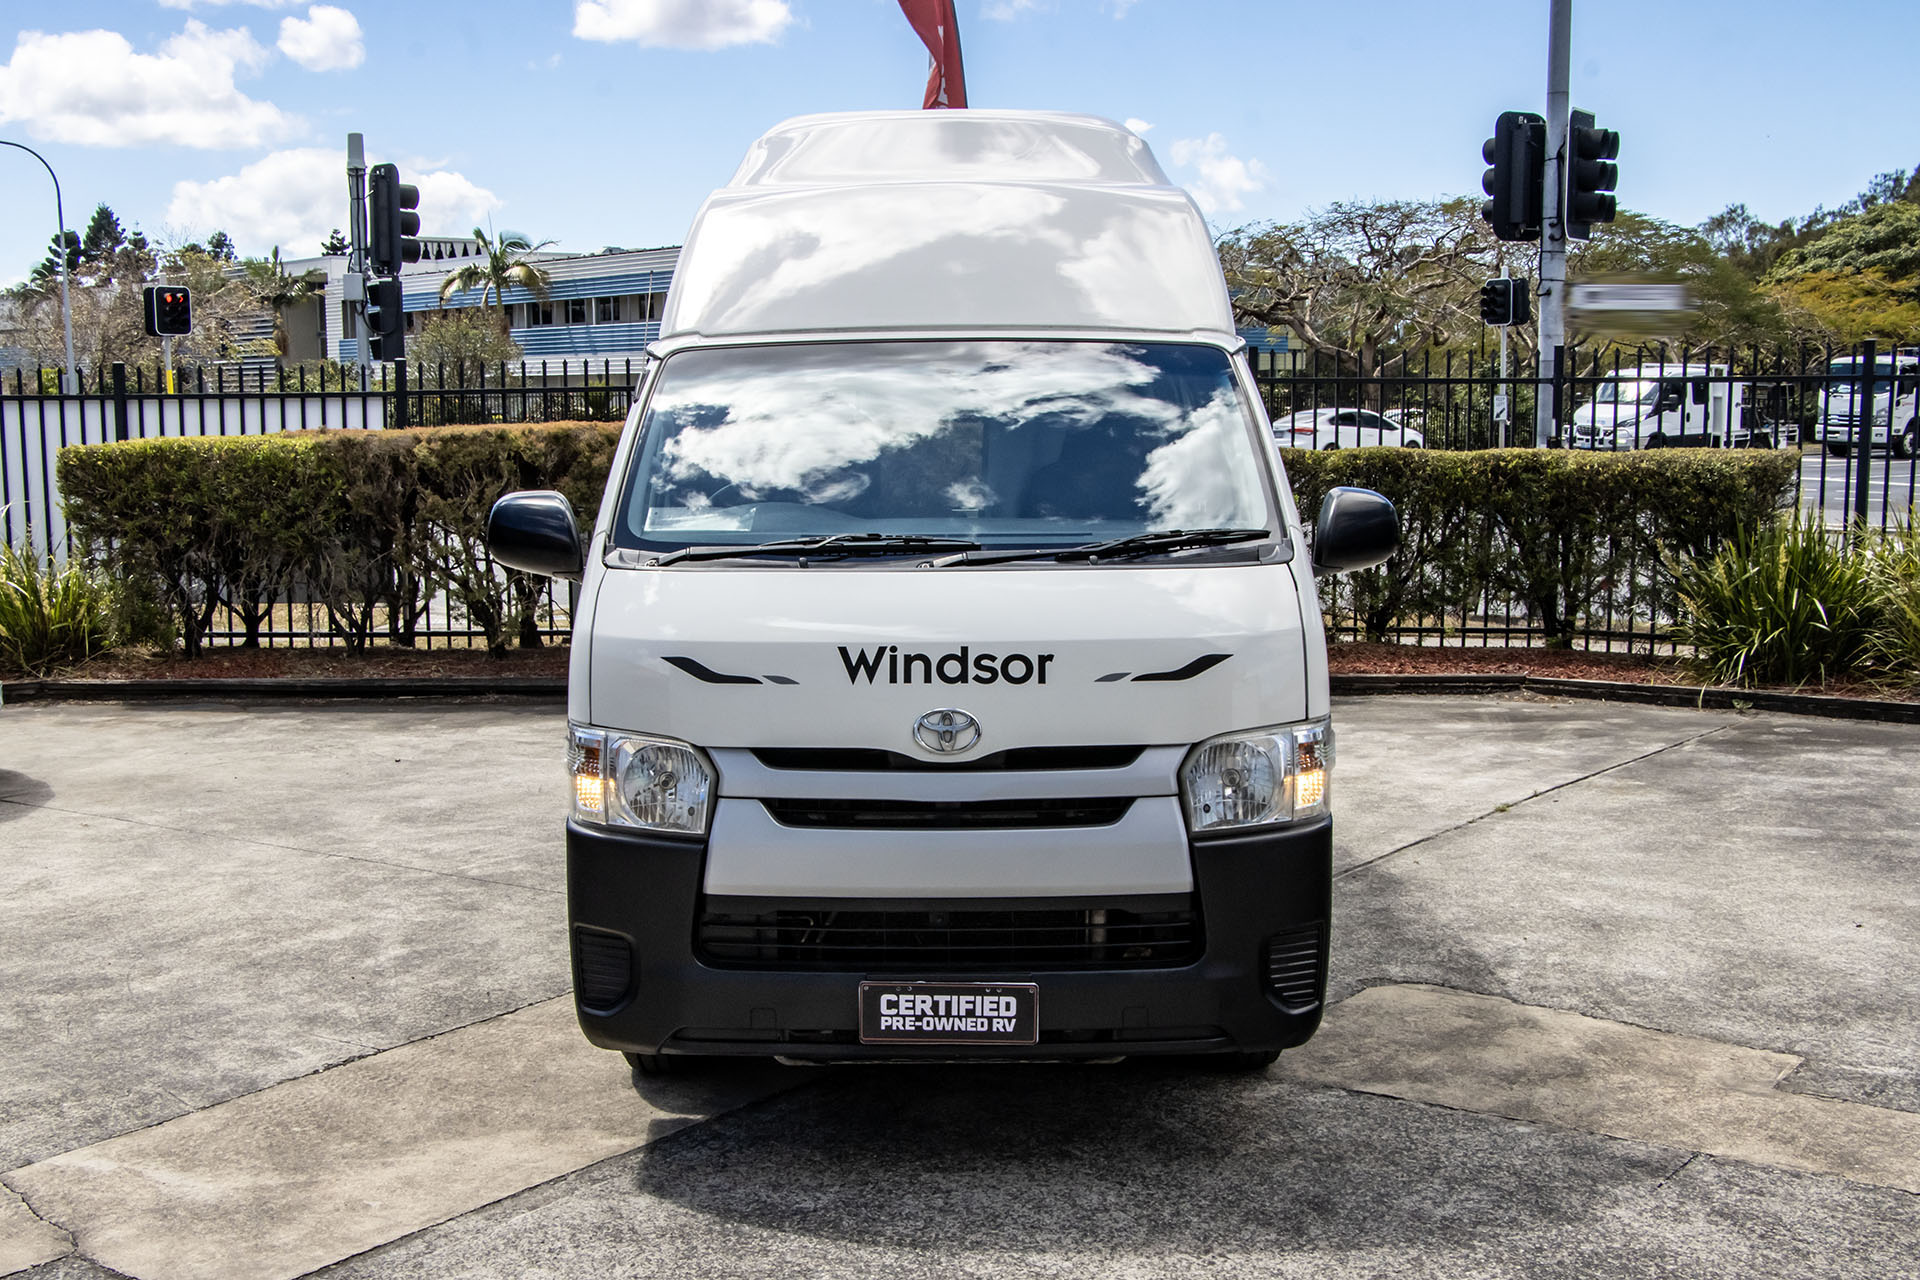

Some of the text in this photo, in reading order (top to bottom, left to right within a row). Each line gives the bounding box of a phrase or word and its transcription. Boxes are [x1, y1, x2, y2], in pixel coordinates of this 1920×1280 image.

[837, 645, 1055, 685] Windsor
[880, 994, 1017, 1017] CERTIFIED
[880, 1016, 1017, 1032] PRE-OWNED RV
